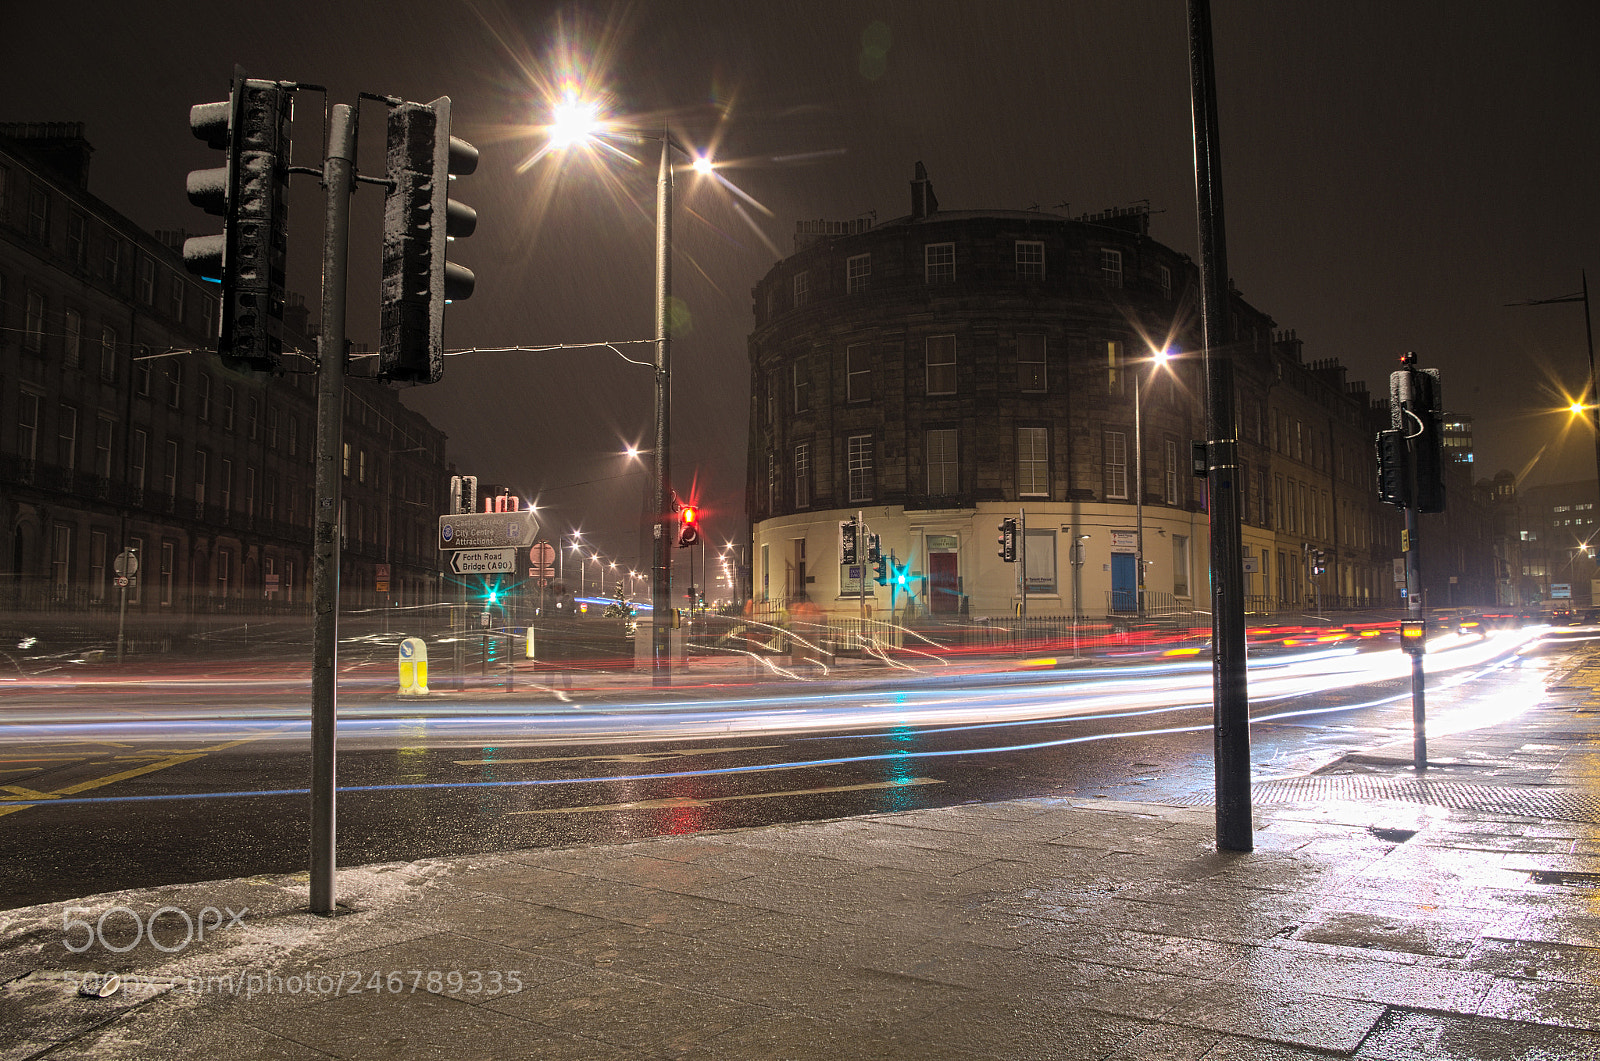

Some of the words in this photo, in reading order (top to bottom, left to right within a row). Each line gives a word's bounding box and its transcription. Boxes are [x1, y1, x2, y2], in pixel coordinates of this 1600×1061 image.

[455, 529, 469, 538] City
[471, 528, 494, 536] Centre
[455, 538, 494, 546] Attractions
[463, 563, 485, 571] Bridge
[487, 562, 512, 571] (A90)
